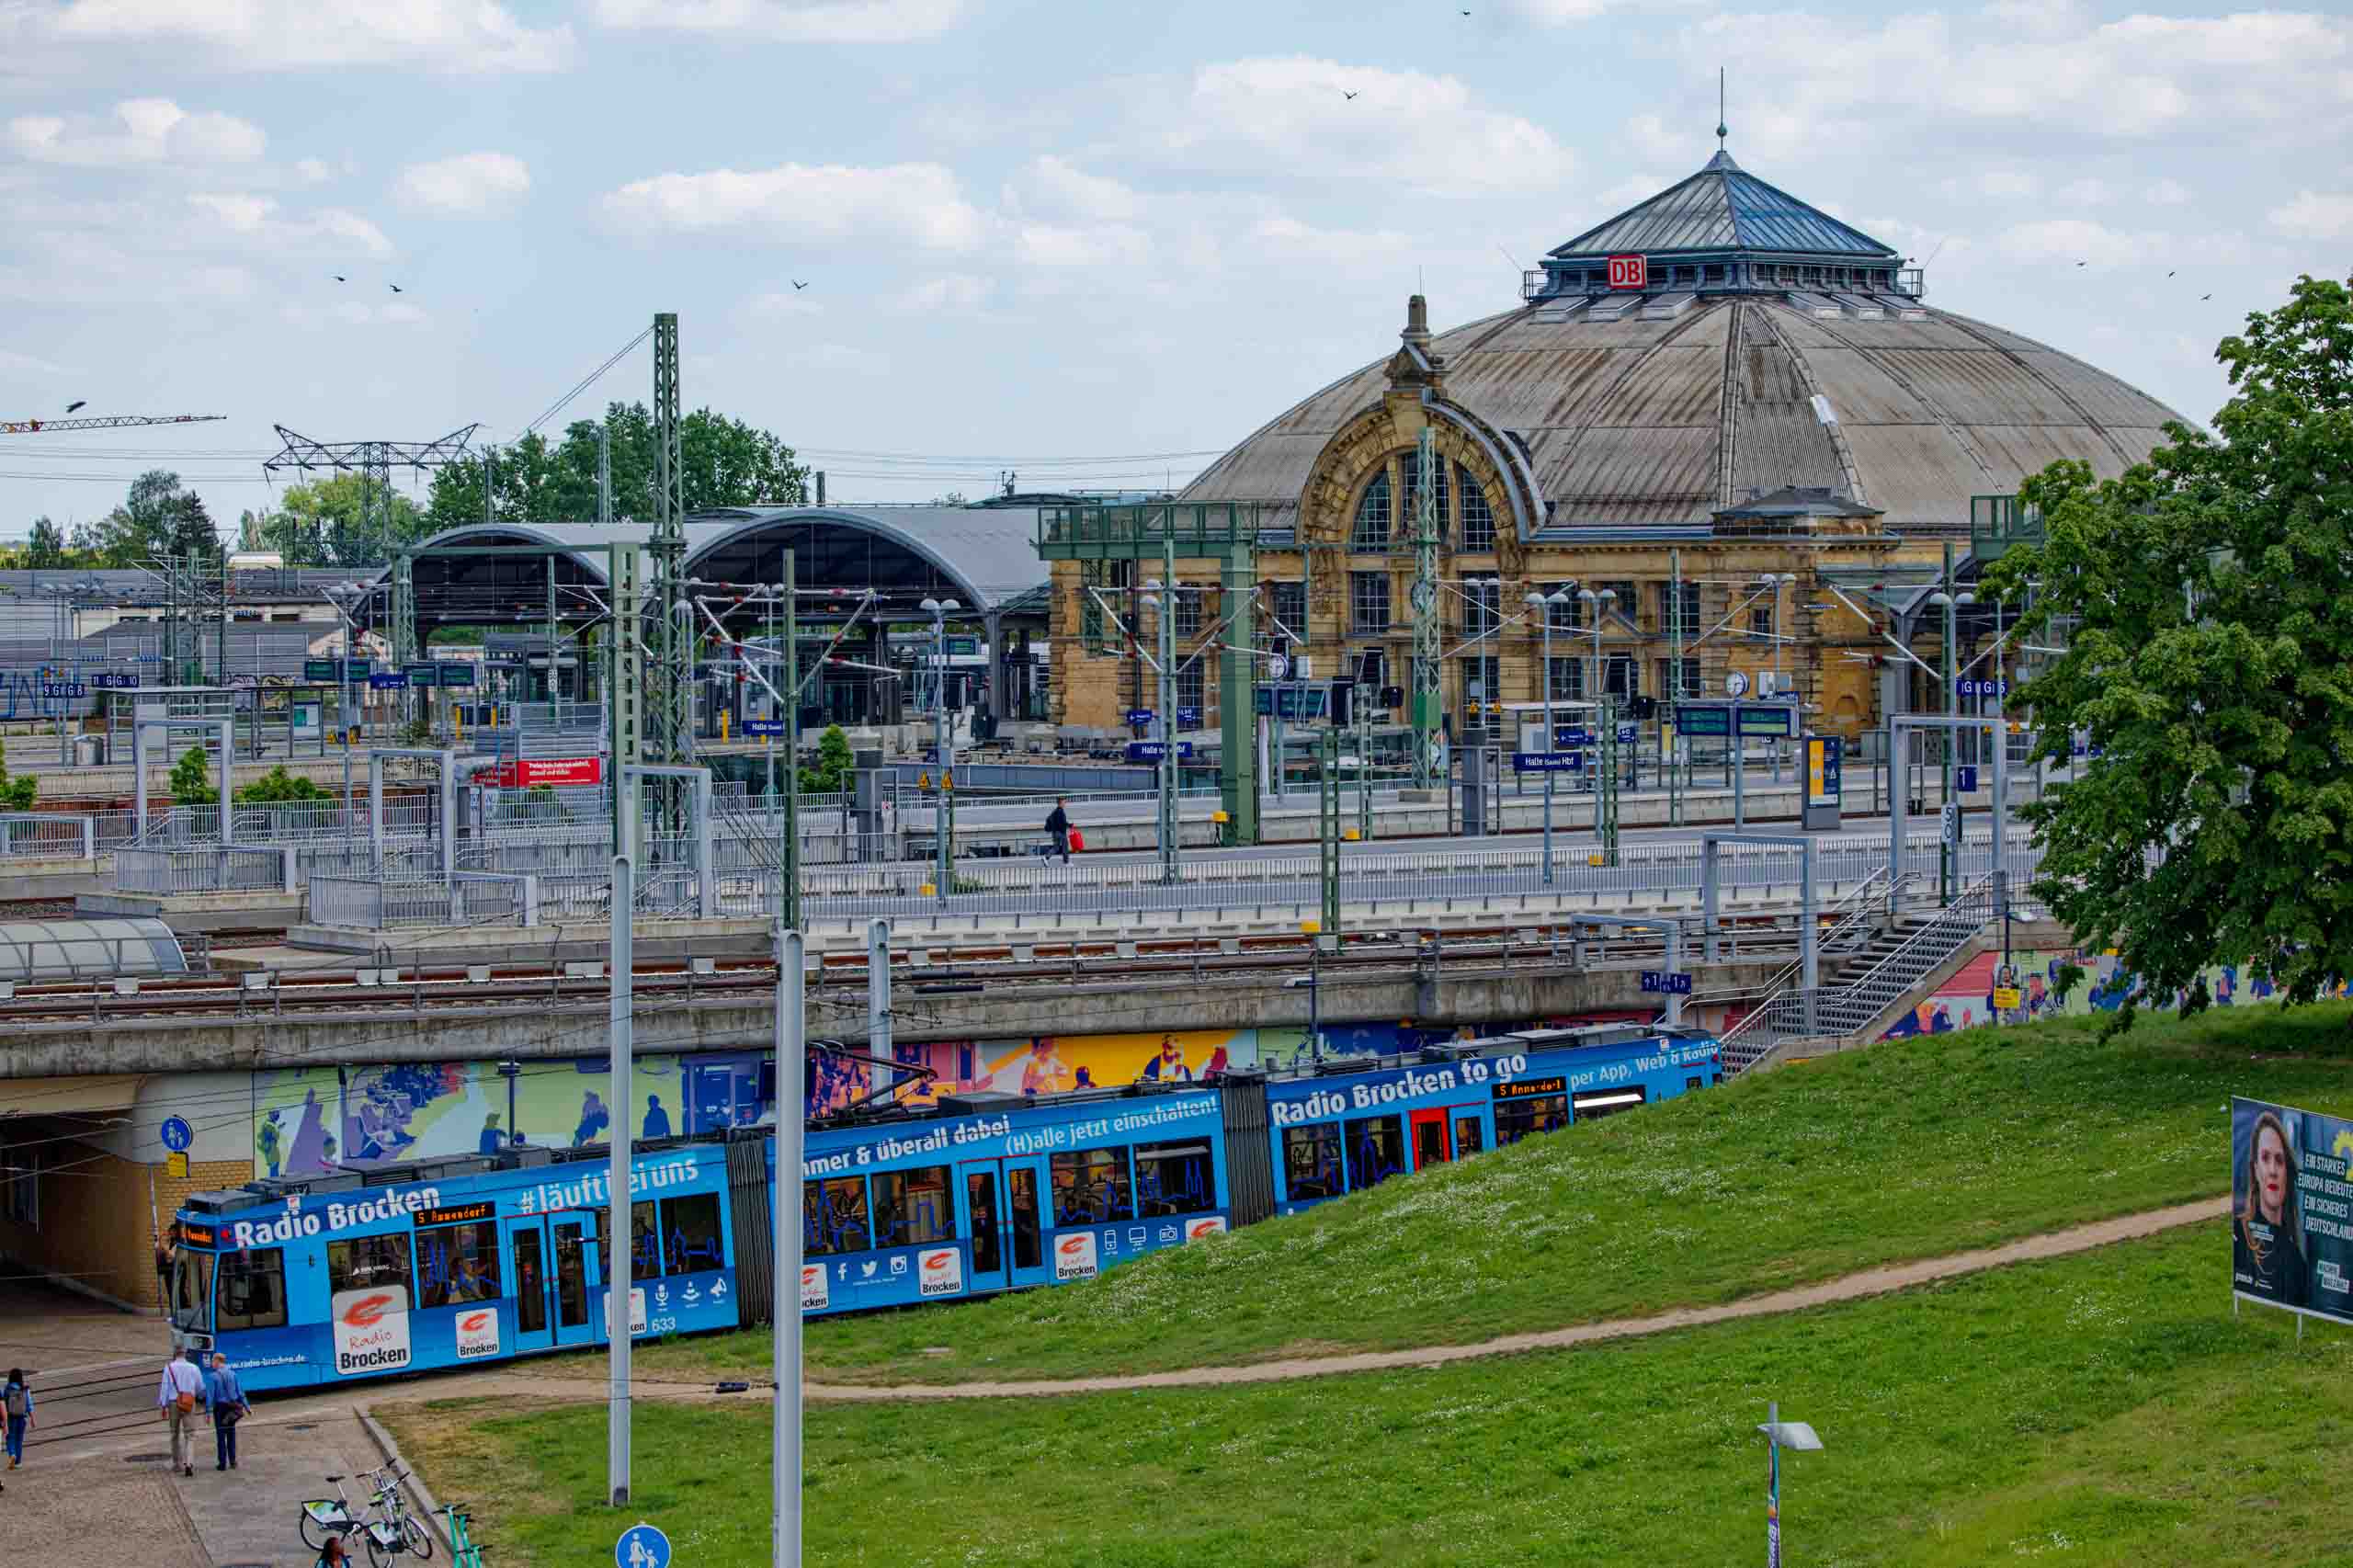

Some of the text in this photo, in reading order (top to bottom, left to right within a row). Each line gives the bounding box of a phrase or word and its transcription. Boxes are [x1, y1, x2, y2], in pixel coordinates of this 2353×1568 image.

[1612, 261, 1640, 283] DB
[130, 676, 137, 685] 10
[1964, 681, 1972, 691] G
[1984, 681, 1991, 691] G
[1142, 745, 1158, 755] Halle
[1525, 756, 1543, 766] Halle
[1562, 756, 1574, 766] Hbf
[1959, 769, 1966, 788] 1
[1570, 1070, 1597, 1092] per
[1599, 1064, 1633, 1085] App,
[1635, 1053, 1667, 1073] Web
[1271, 1054, 1528, 1127] Radio Brocken to go
[1006, 1095, 1218, 1155] (H)alle jetzt einschalten!
[856, 1146, 872, 1165] &
[876, 1126, 949, 1162] überall
[953, 1114, 1011, 1144] dabei
[652, 1158, 699, 1187] uns
[2304, 1153, 2346, 1176] EIN STARKES
[2298, 1172, 2353, 1199] EUROPA BEDEUTE
[234, 1187, 441, 1249] Radio Brocken
[2304, 1195, 2348, 1219] EIN SICHERES
[1058, 1266, 1096, 1278] Brocken
[922, 1281, 960, 1294] Brocken
[651, 1316, 676, 1332] 633
[348, 1330, 392, 1352] Radio
[460, 1343, 498, 1356] Brocken
[341, 1347, 408, 1369] Brocken
